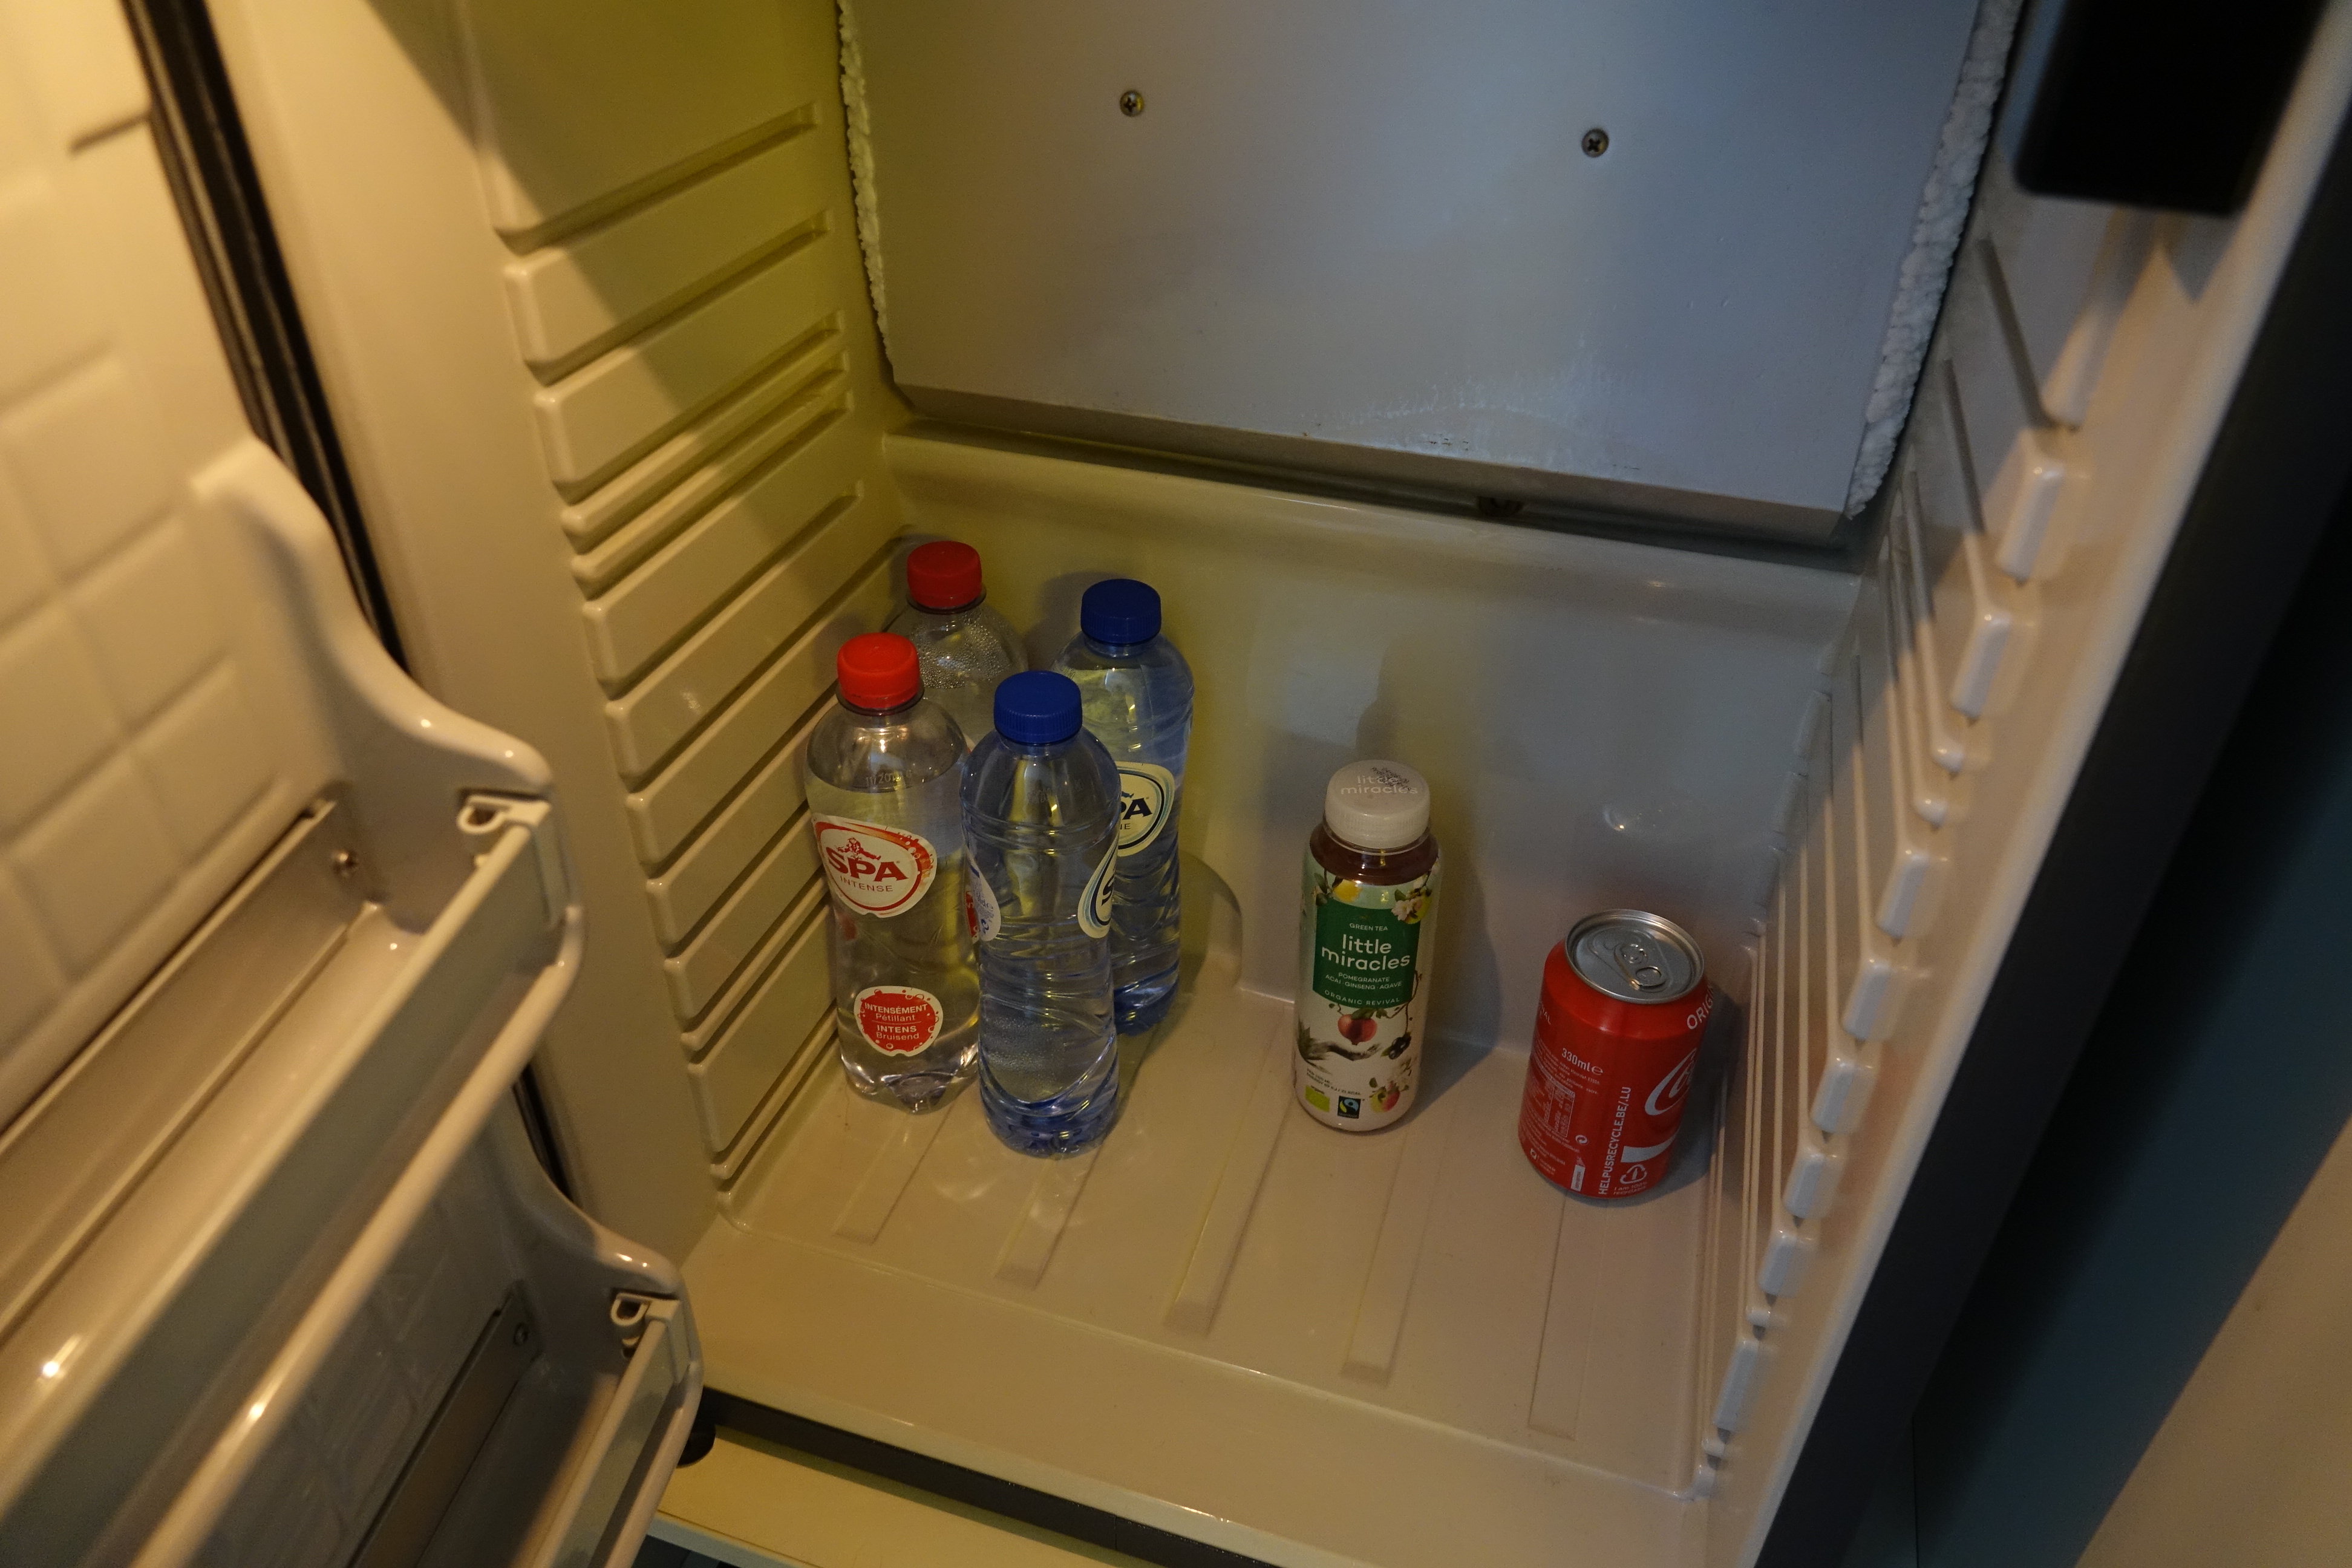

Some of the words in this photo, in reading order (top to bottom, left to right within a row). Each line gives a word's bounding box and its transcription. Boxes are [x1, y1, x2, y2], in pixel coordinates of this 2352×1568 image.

[1341, 785, 1418, 794] miracles
[826, 846, 909, 882] SPA
[840, 875, 893, 892] INTENSE
[1349, 923, 1374, 931] GREEN
[1342, 933, 1392, 955] little
[1321, 946, 1411, 971] miracles
[1338, 972, 1390, 983] POMEGRANATE
[1344, 981, 1376, 990] GINSENG
[1379, 981, 1402, 990] AGAVE
[1324, 989, 1362, 1005] ORGANIC
[1365, 997, 1400, 1005] REVIVAL
[864, 1002, 929, 1014] INTENSÉMENT
[875, 1013, 916, 1022] Pétillant
[877, 1024, 917, 1033] INTENS
[876, 1031, 920, 1040] Bruisend
[1598, 1086, 1632, 1195] HELPUSRECYCLE.BE/.LU
